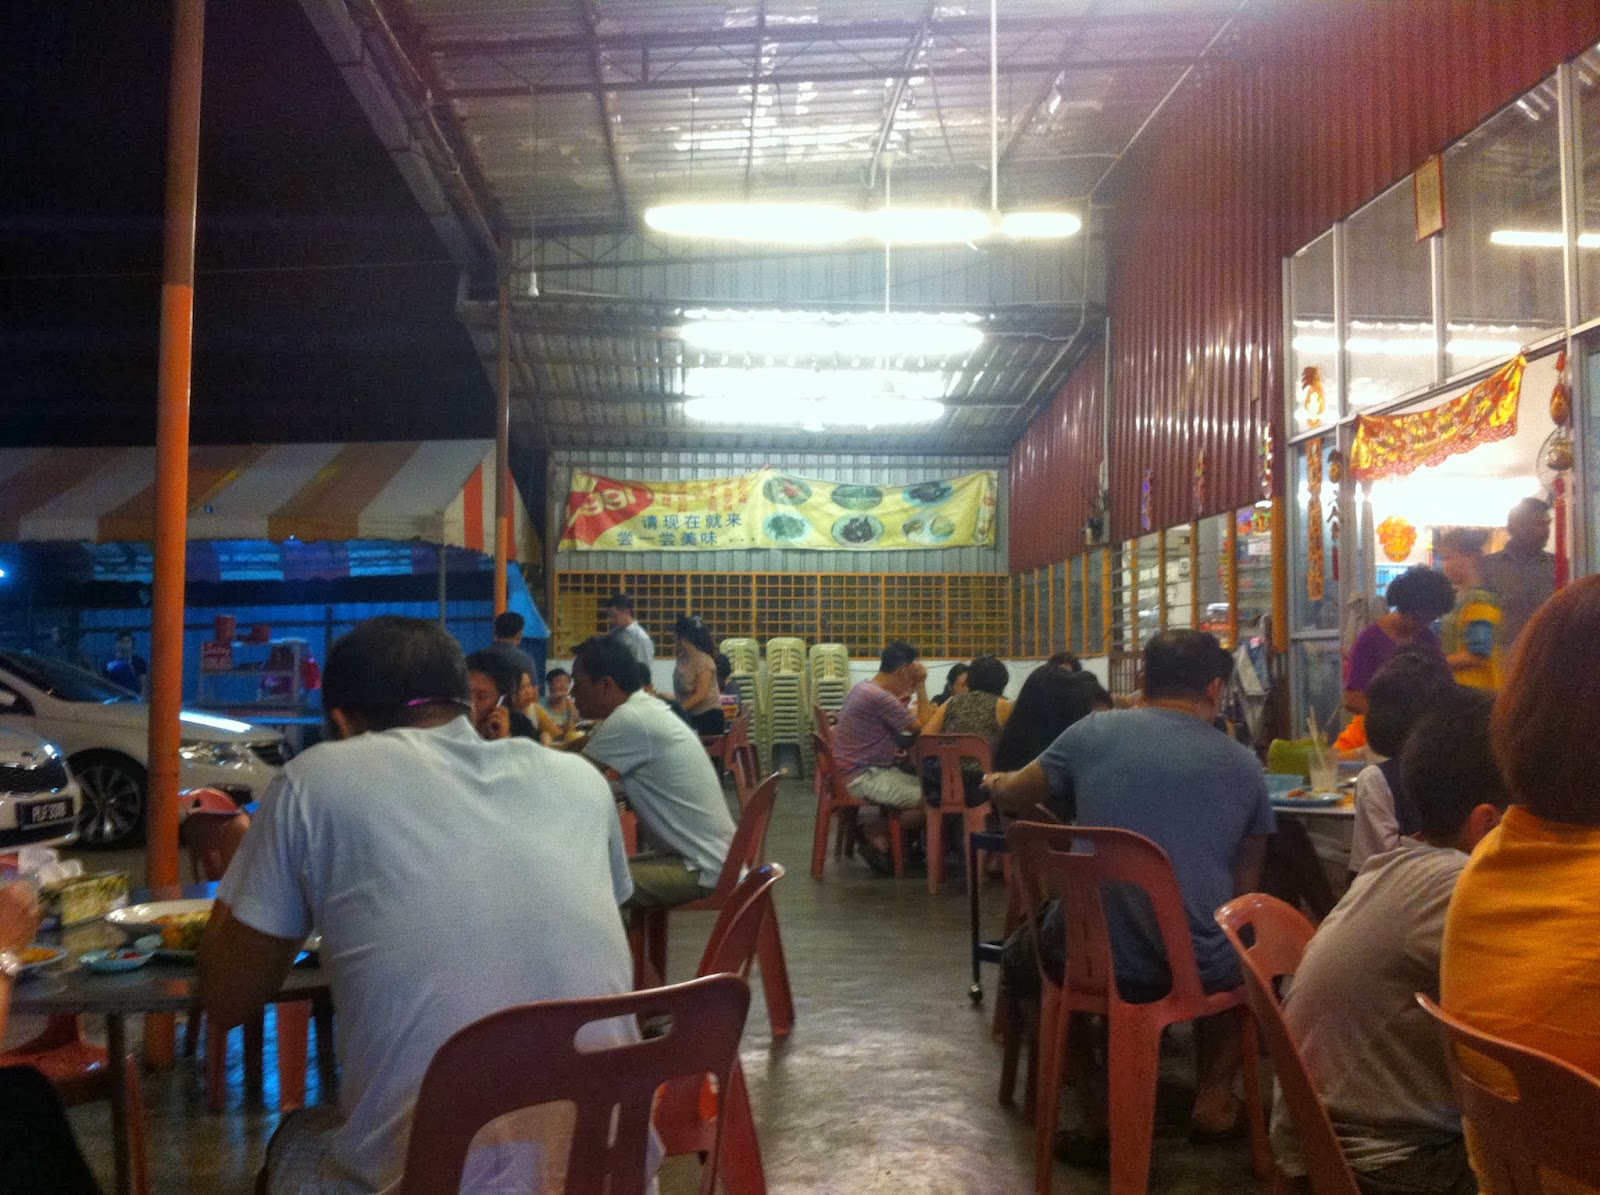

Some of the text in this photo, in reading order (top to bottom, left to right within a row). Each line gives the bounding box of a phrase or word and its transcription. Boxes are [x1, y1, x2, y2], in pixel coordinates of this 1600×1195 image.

[641, 513, 741, 530] 请现在就来
